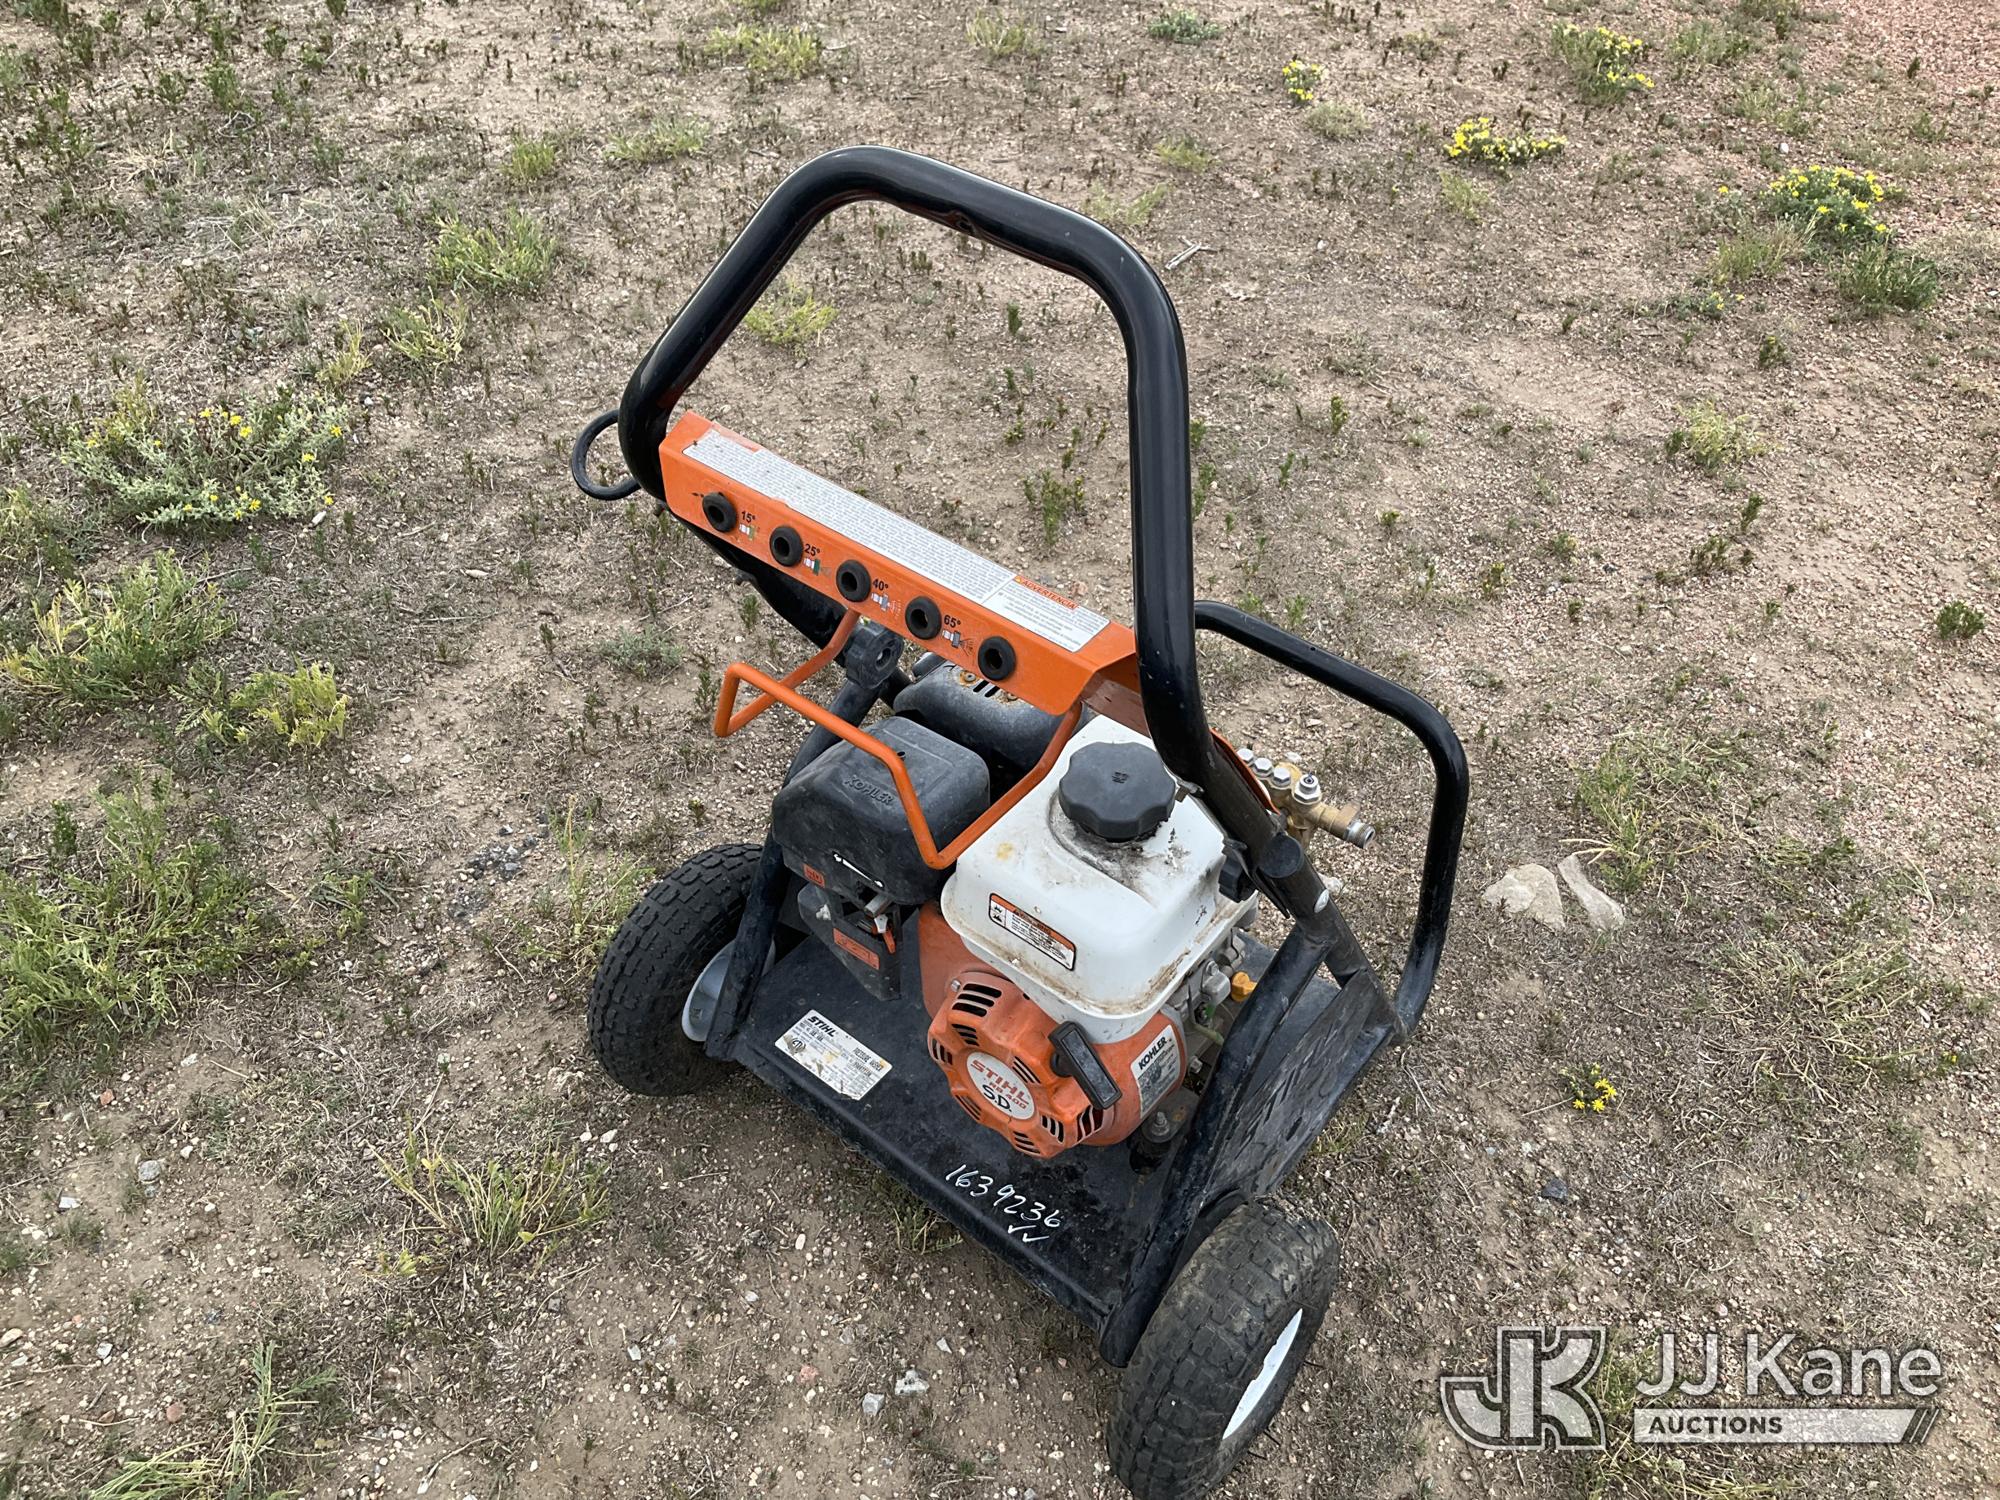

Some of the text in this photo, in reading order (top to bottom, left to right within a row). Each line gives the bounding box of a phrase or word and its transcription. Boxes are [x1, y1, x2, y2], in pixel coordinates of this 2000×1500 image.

[843, 775, 894, 806] KOHLER
[808, 1015, 836, 1038] STIHL
[1139, 1037, 1167, 1070] KOHLER
[971, 1059, 1029, 1105] STIHL
[945, 1164, 1061, 1228] 1639236
